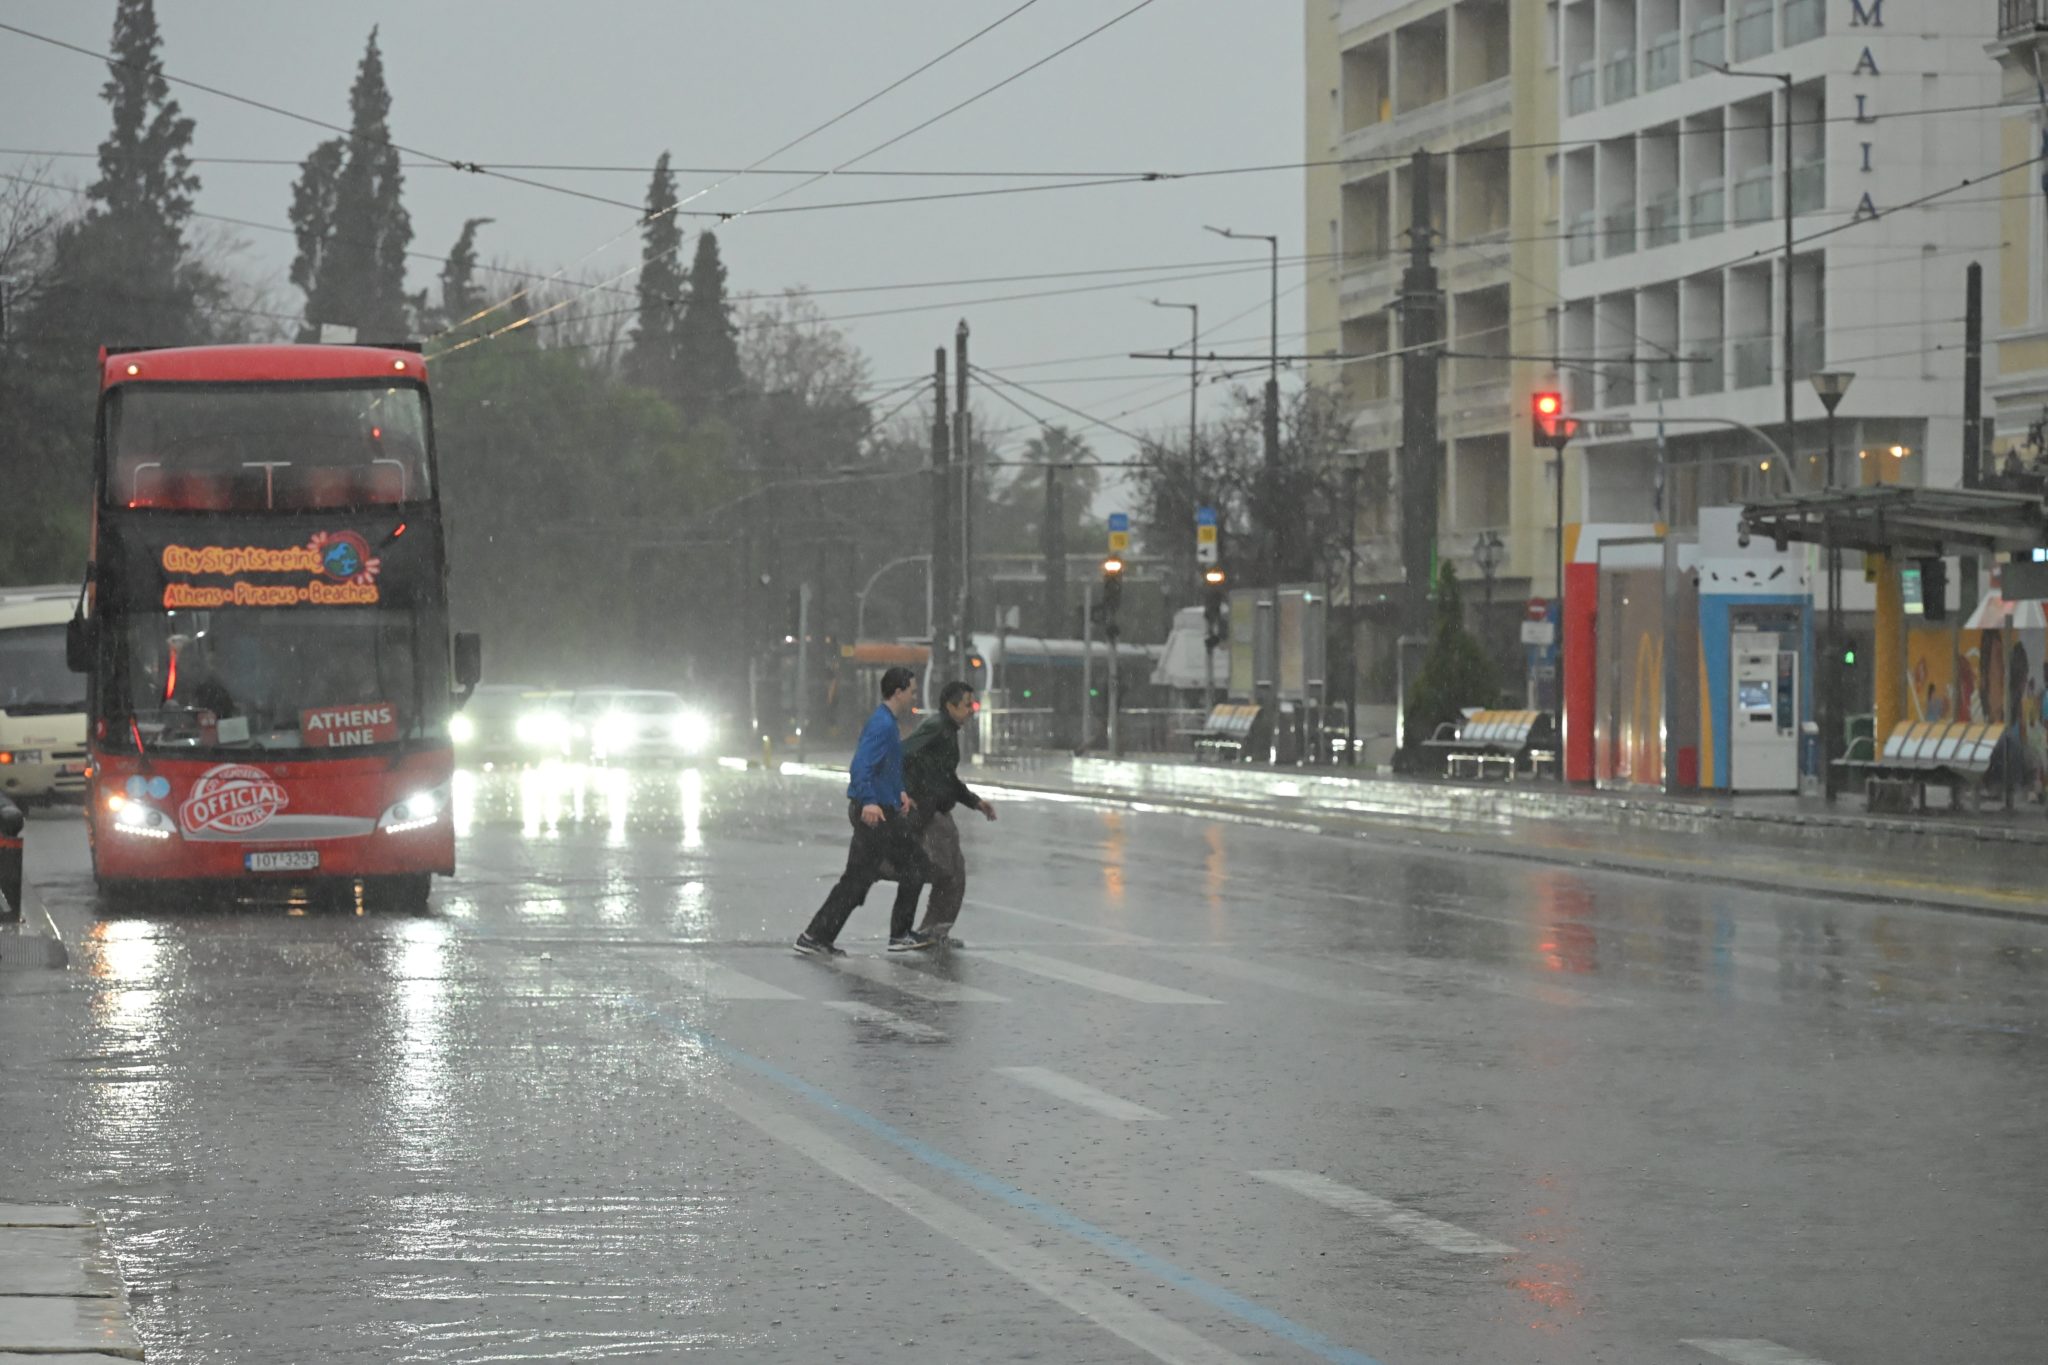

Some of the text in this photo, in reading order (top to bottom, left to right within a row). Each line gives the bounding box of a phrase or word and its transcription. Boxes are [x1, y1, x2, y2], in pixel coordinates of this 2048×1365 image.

[1849, 0, 1883, 222] MALIA
[167, 582, 377, 604] Athens Piraeus Beaches
[308, 708, 392, 730] ATHENS
[328, 729, 373, 747] LINE
[193, 785, 284, 822] OFFICIAL
[231, 807, 267, 827] TOUR
